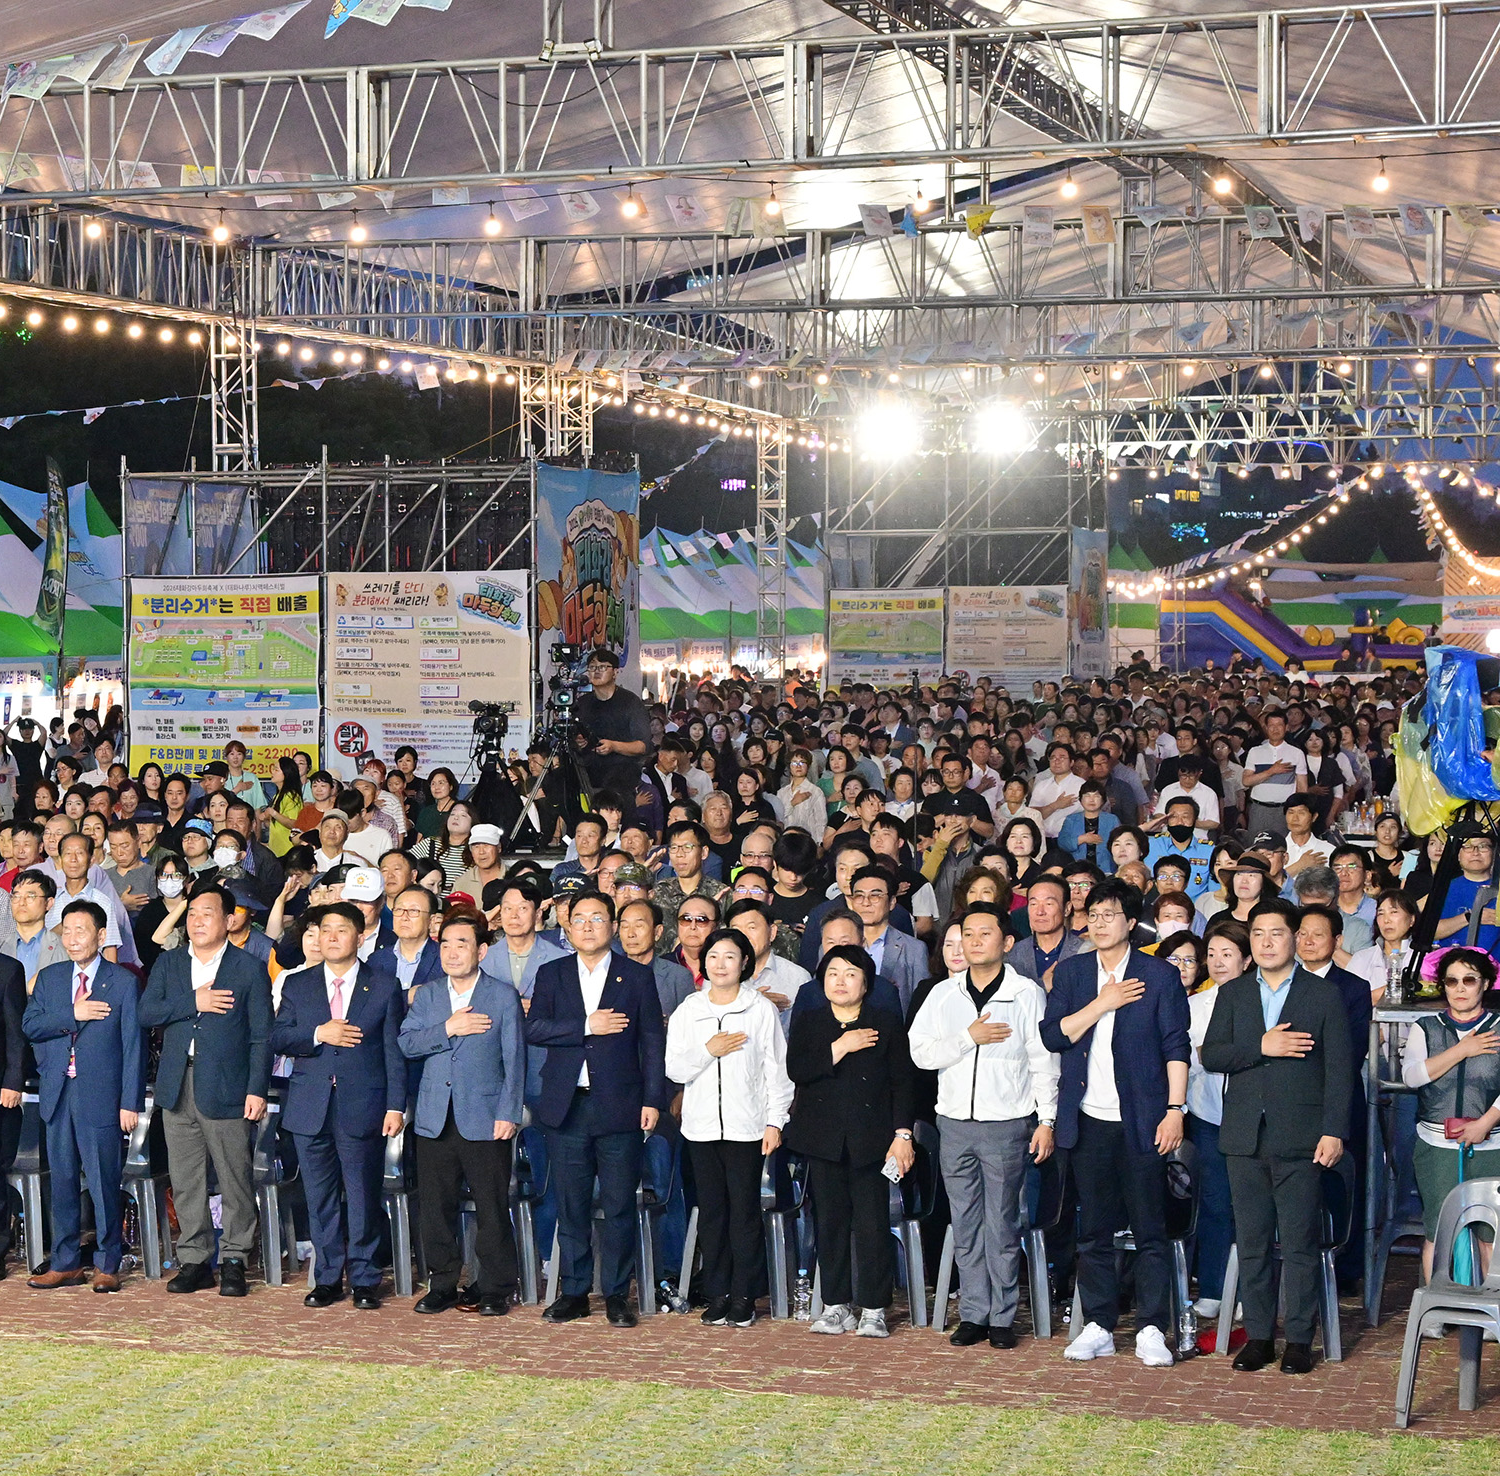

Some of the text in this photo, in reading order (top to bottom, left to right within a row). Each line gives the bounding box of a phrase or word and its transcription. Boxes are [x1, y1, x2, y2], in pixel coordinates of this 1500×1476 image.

[362, 580, 425, 596] 쓰레기를 단디
[352, 594, 390, 607] 분리해서
[479, 584, 515, 607] 태화강
[239, 596, 271, 613] 직접
[277, 594, 308, 612] 배출
[340, 725, 364, 738] 절대
[340, 740, 364, 753] 금지
[149, 748, 194, 760] F&B판매
[198, 748, 208, 760] 및
[163, 763, 276, 775] 행사종료 ~23:0
